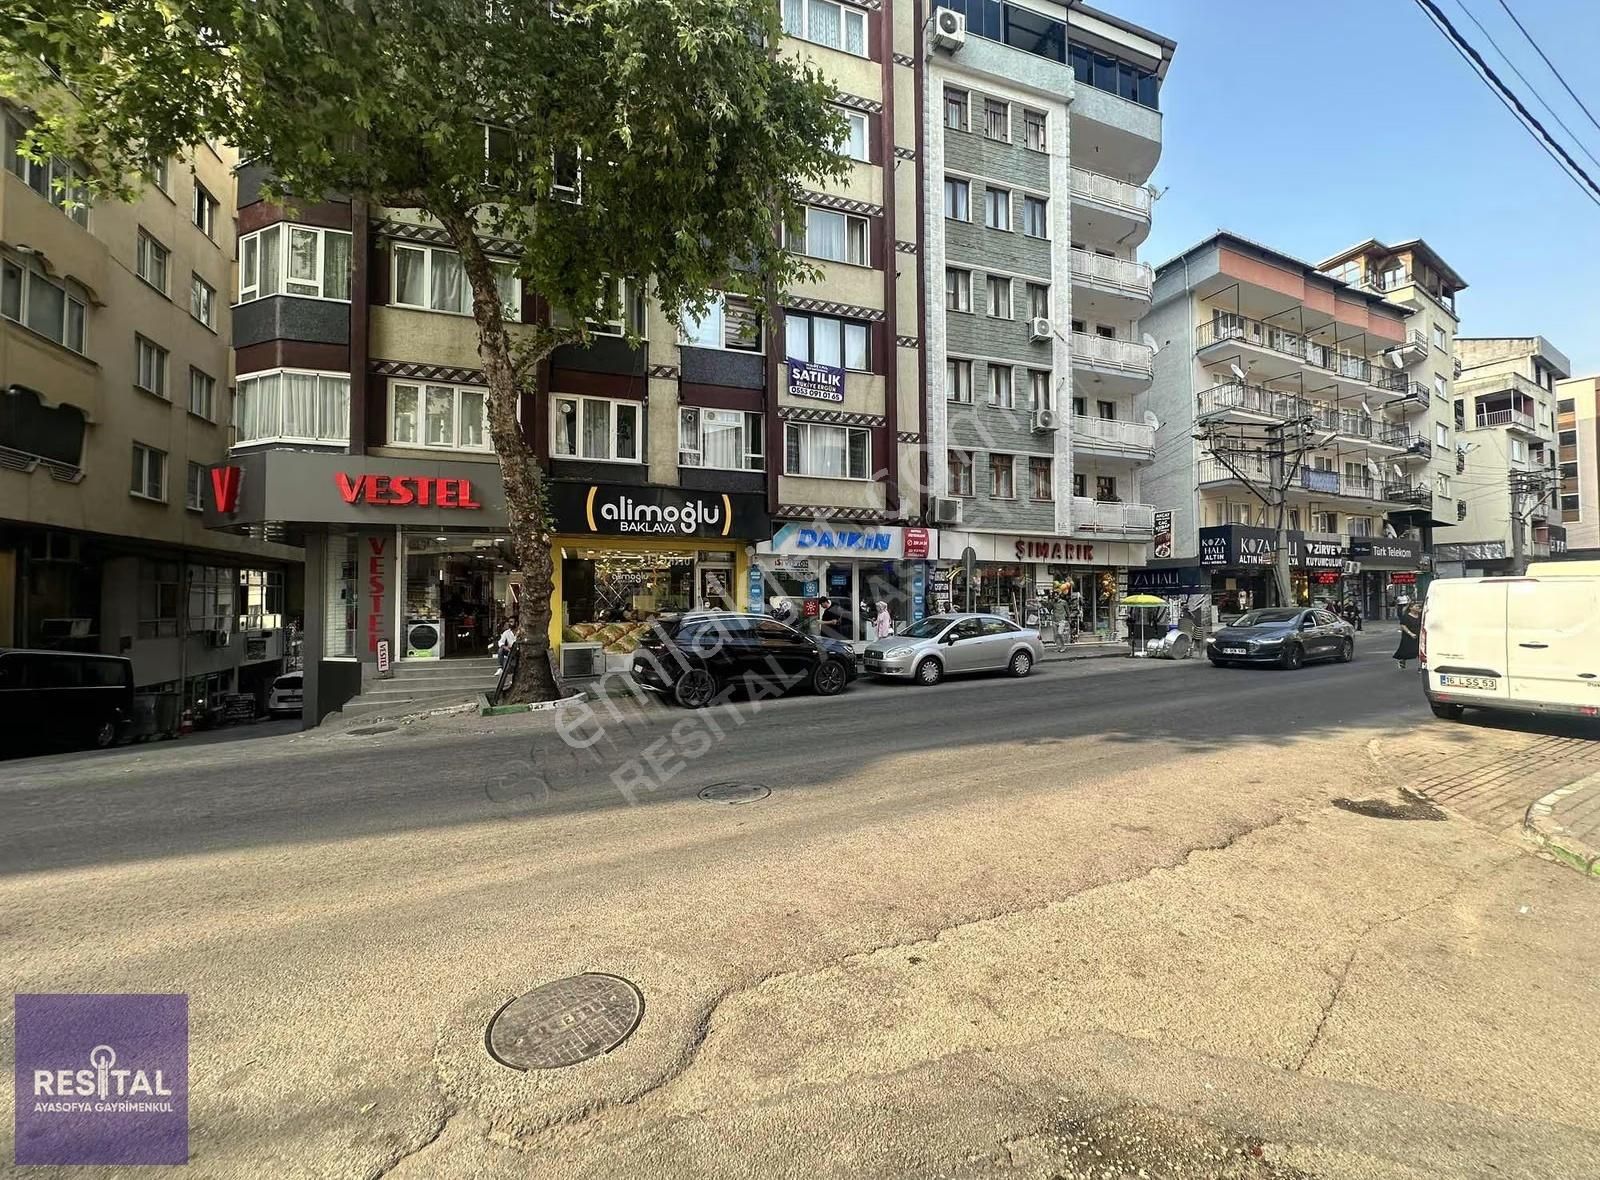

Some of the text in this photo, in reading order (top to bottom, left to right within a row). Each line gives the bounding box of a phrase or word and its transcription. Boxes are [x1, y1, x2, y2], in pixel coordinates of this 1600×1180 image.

[792, 368, 841, 386] SATILIK
[791, 386, 808, 395] 0553
[336, 472, 481, 509] VESTEL
[601, 496, 720, 534] alimoğlu
[620, 522, 676, 533] BAKLAVA
[797, 529, 892, 551] DAIKIN
[1202, 537, 1226, 547] KOZA
[1241, 537, 1270, 553] KOZA
[1314, 541, 1336, 555] ZİRVE
[1373, 546, 1412, 557] Türk Telekom
[1239, 554, 1258, 564] ALTIN
[368, 537, 385, 652] VESTEL
[1482, 679, 1494, 687] 53
